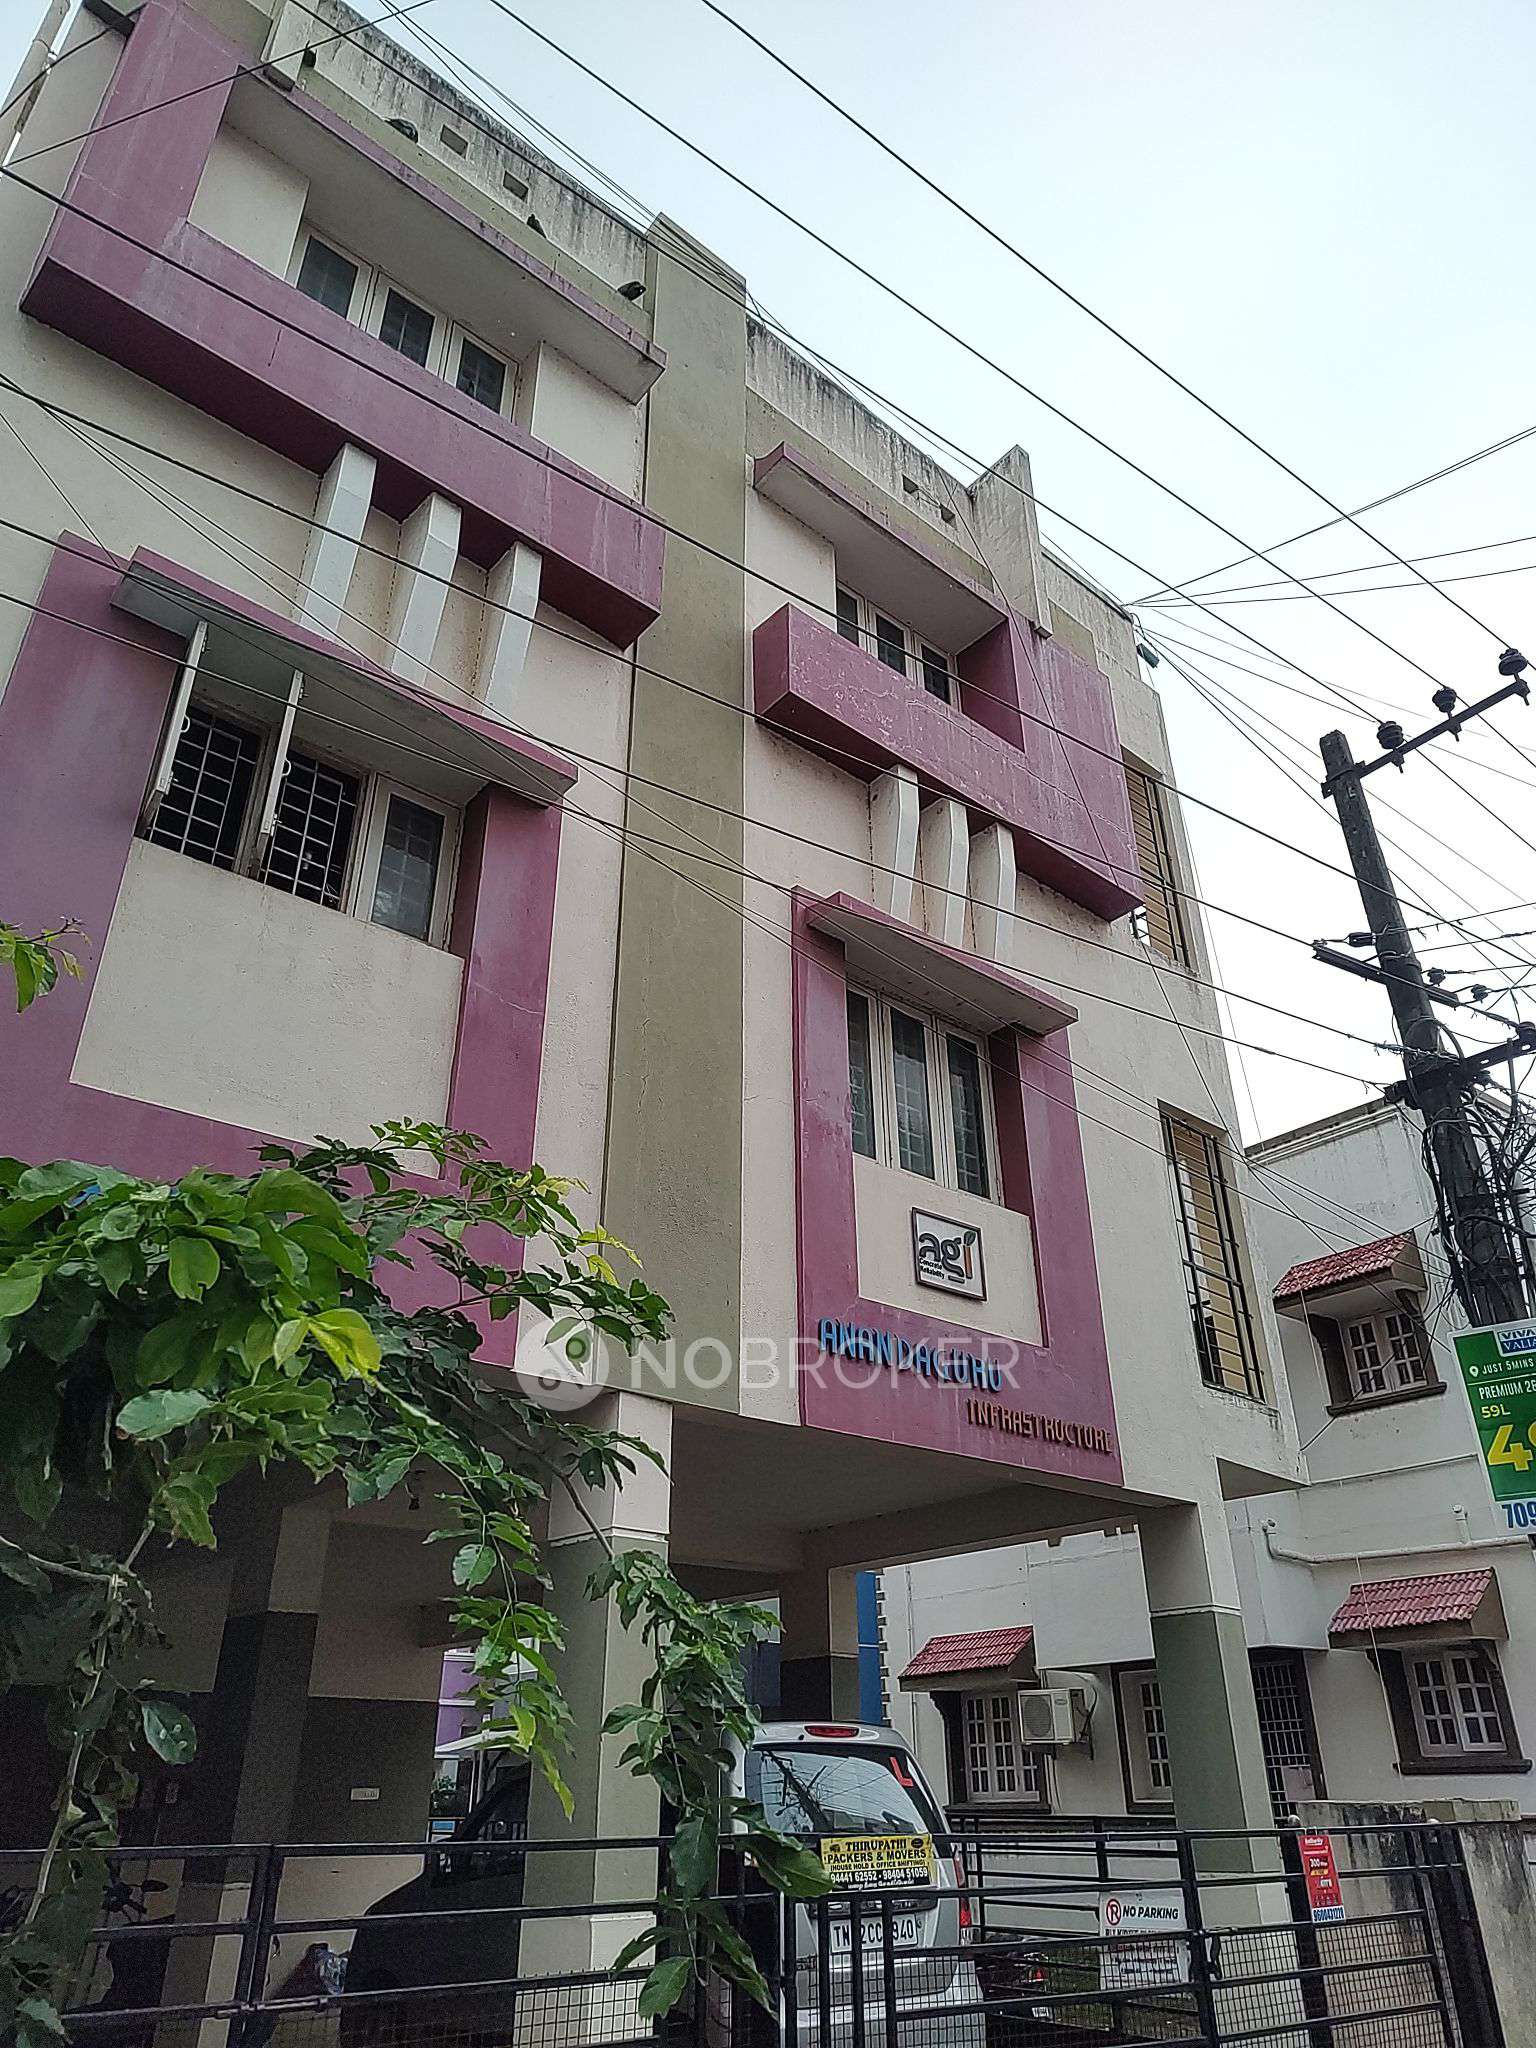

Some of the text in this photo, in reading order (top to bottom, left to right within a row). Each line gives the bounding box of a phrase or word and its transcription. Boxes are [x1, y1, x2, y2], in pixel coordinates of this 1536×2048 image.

[818, 1317, 1002, 1392] ANANDAGURU
[1482, 1358, 1534, 1375] JUST 5MINS
[1479, 1381, 1524, 1400] PREMIUM
[1481, 1404, 1511, 1419] 59L
[967, 1398, 1113, 1453] INFRASTRUCTURE
[845, 1839, 907, 1852] THIRUPATHI
[828, 1849, 927, 1865] PACKERS & MOVERS
[877, 1861, 896, 1869] OFFICE
[830, 1872, 853, 1884] 94441
[854, 1870, 878, 1882] 62552
[882, 1869, 905, 1880] 98404
[906, 1867, 928, 1879] 51059
[1122, 1905, 1179, 1920] NO PARKING
